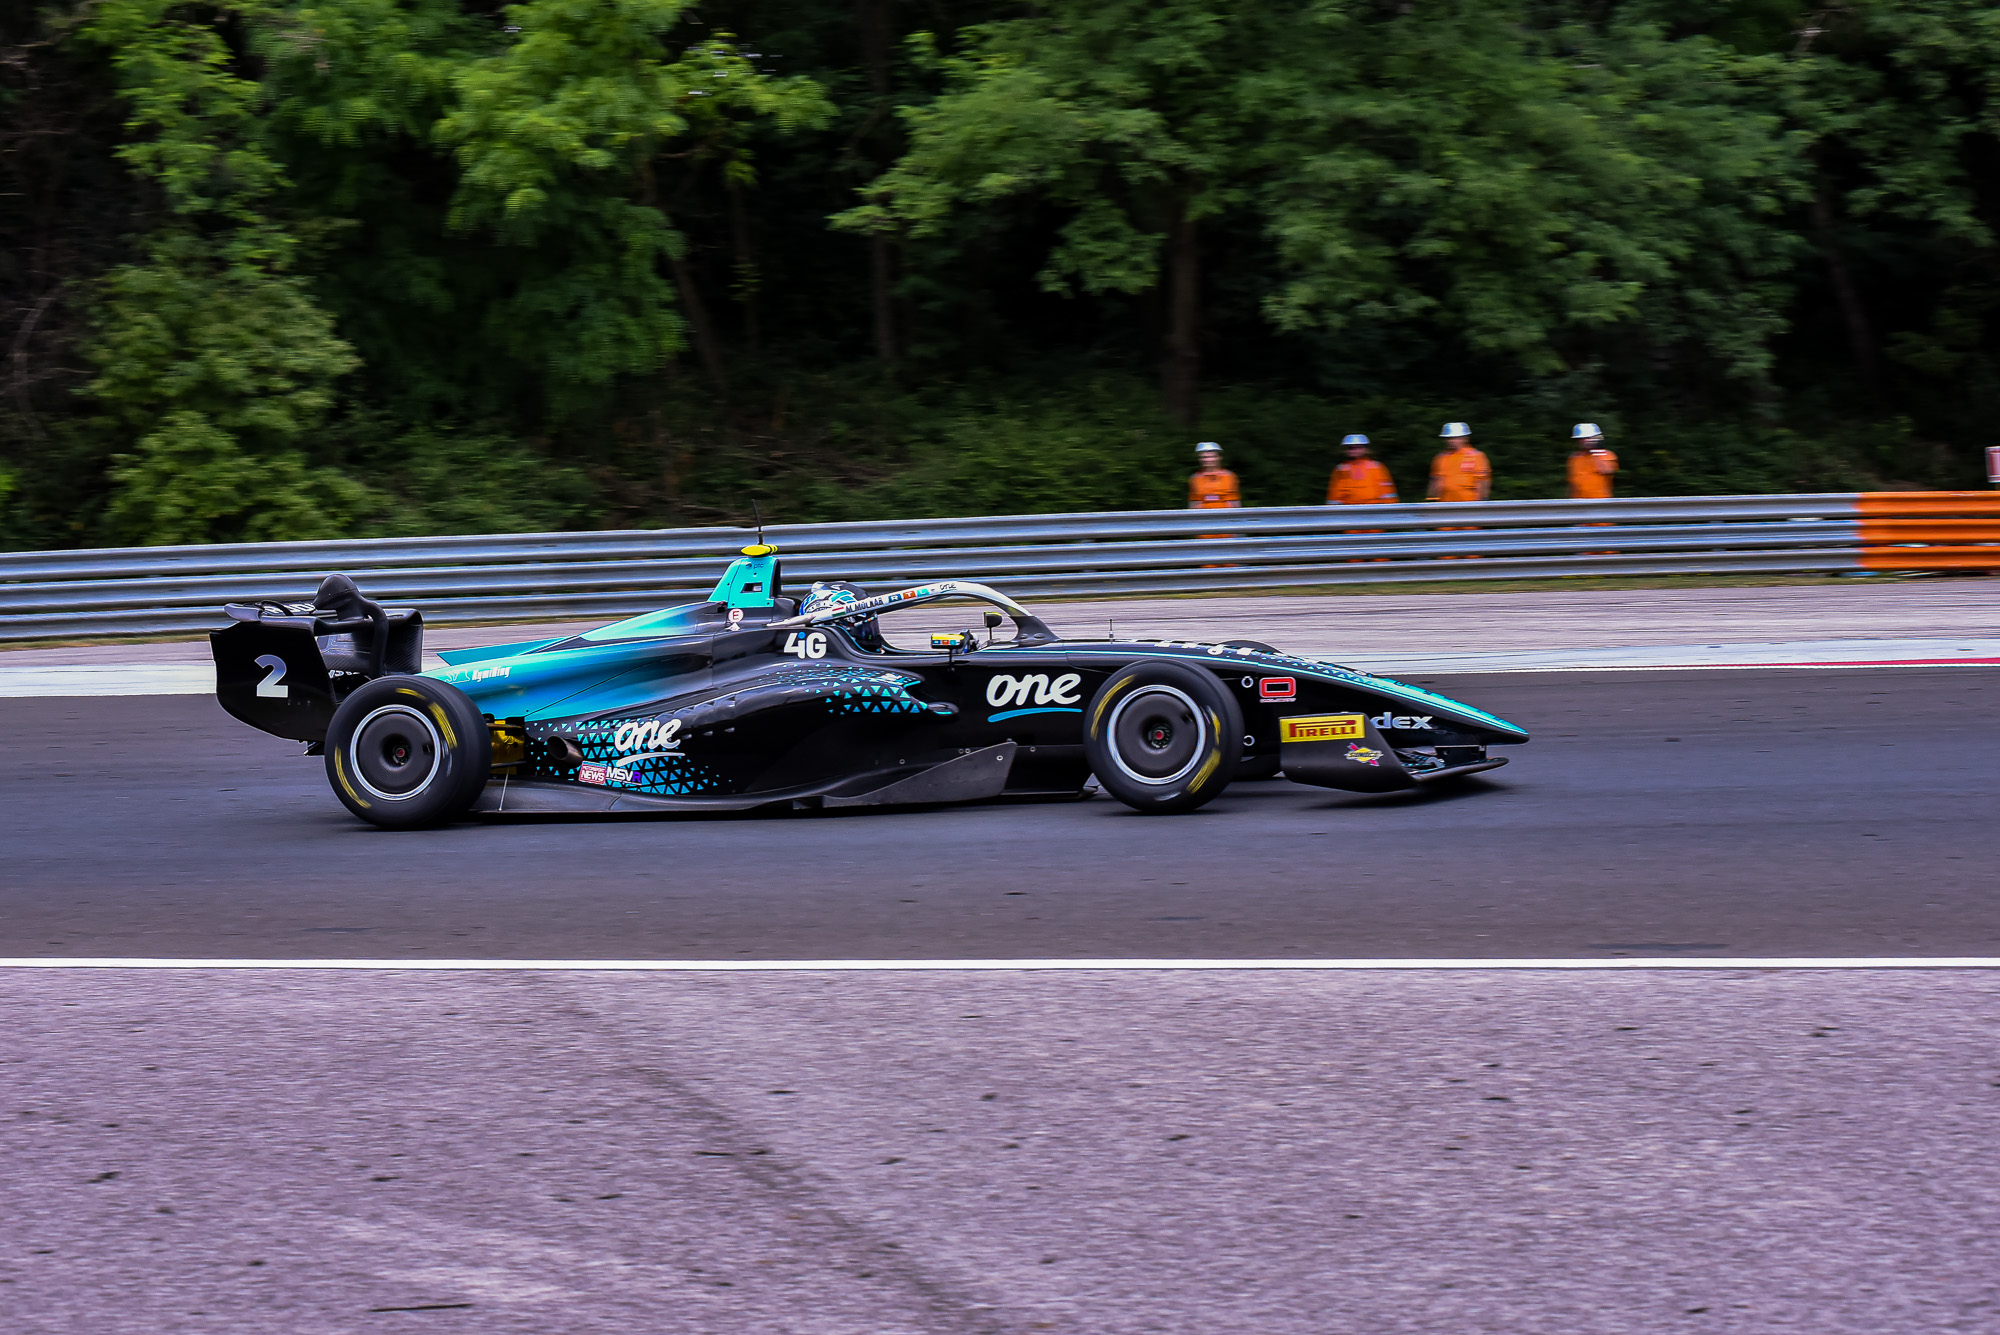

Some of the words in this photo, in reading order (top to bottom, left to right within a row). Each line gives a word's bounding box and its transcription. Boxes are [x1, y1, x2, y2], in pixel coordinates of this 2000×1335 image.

[732, 610, 740, 620] E
[254, 654, 289, 698] 2
[986, 673, 1082, 707] one
[614, 718, 682, 752] one
[1288, 719, 1357, 738] PIRELLI
[580, 769, 605, 782] NEWS
[605, 766, 642, 783] MSVR
